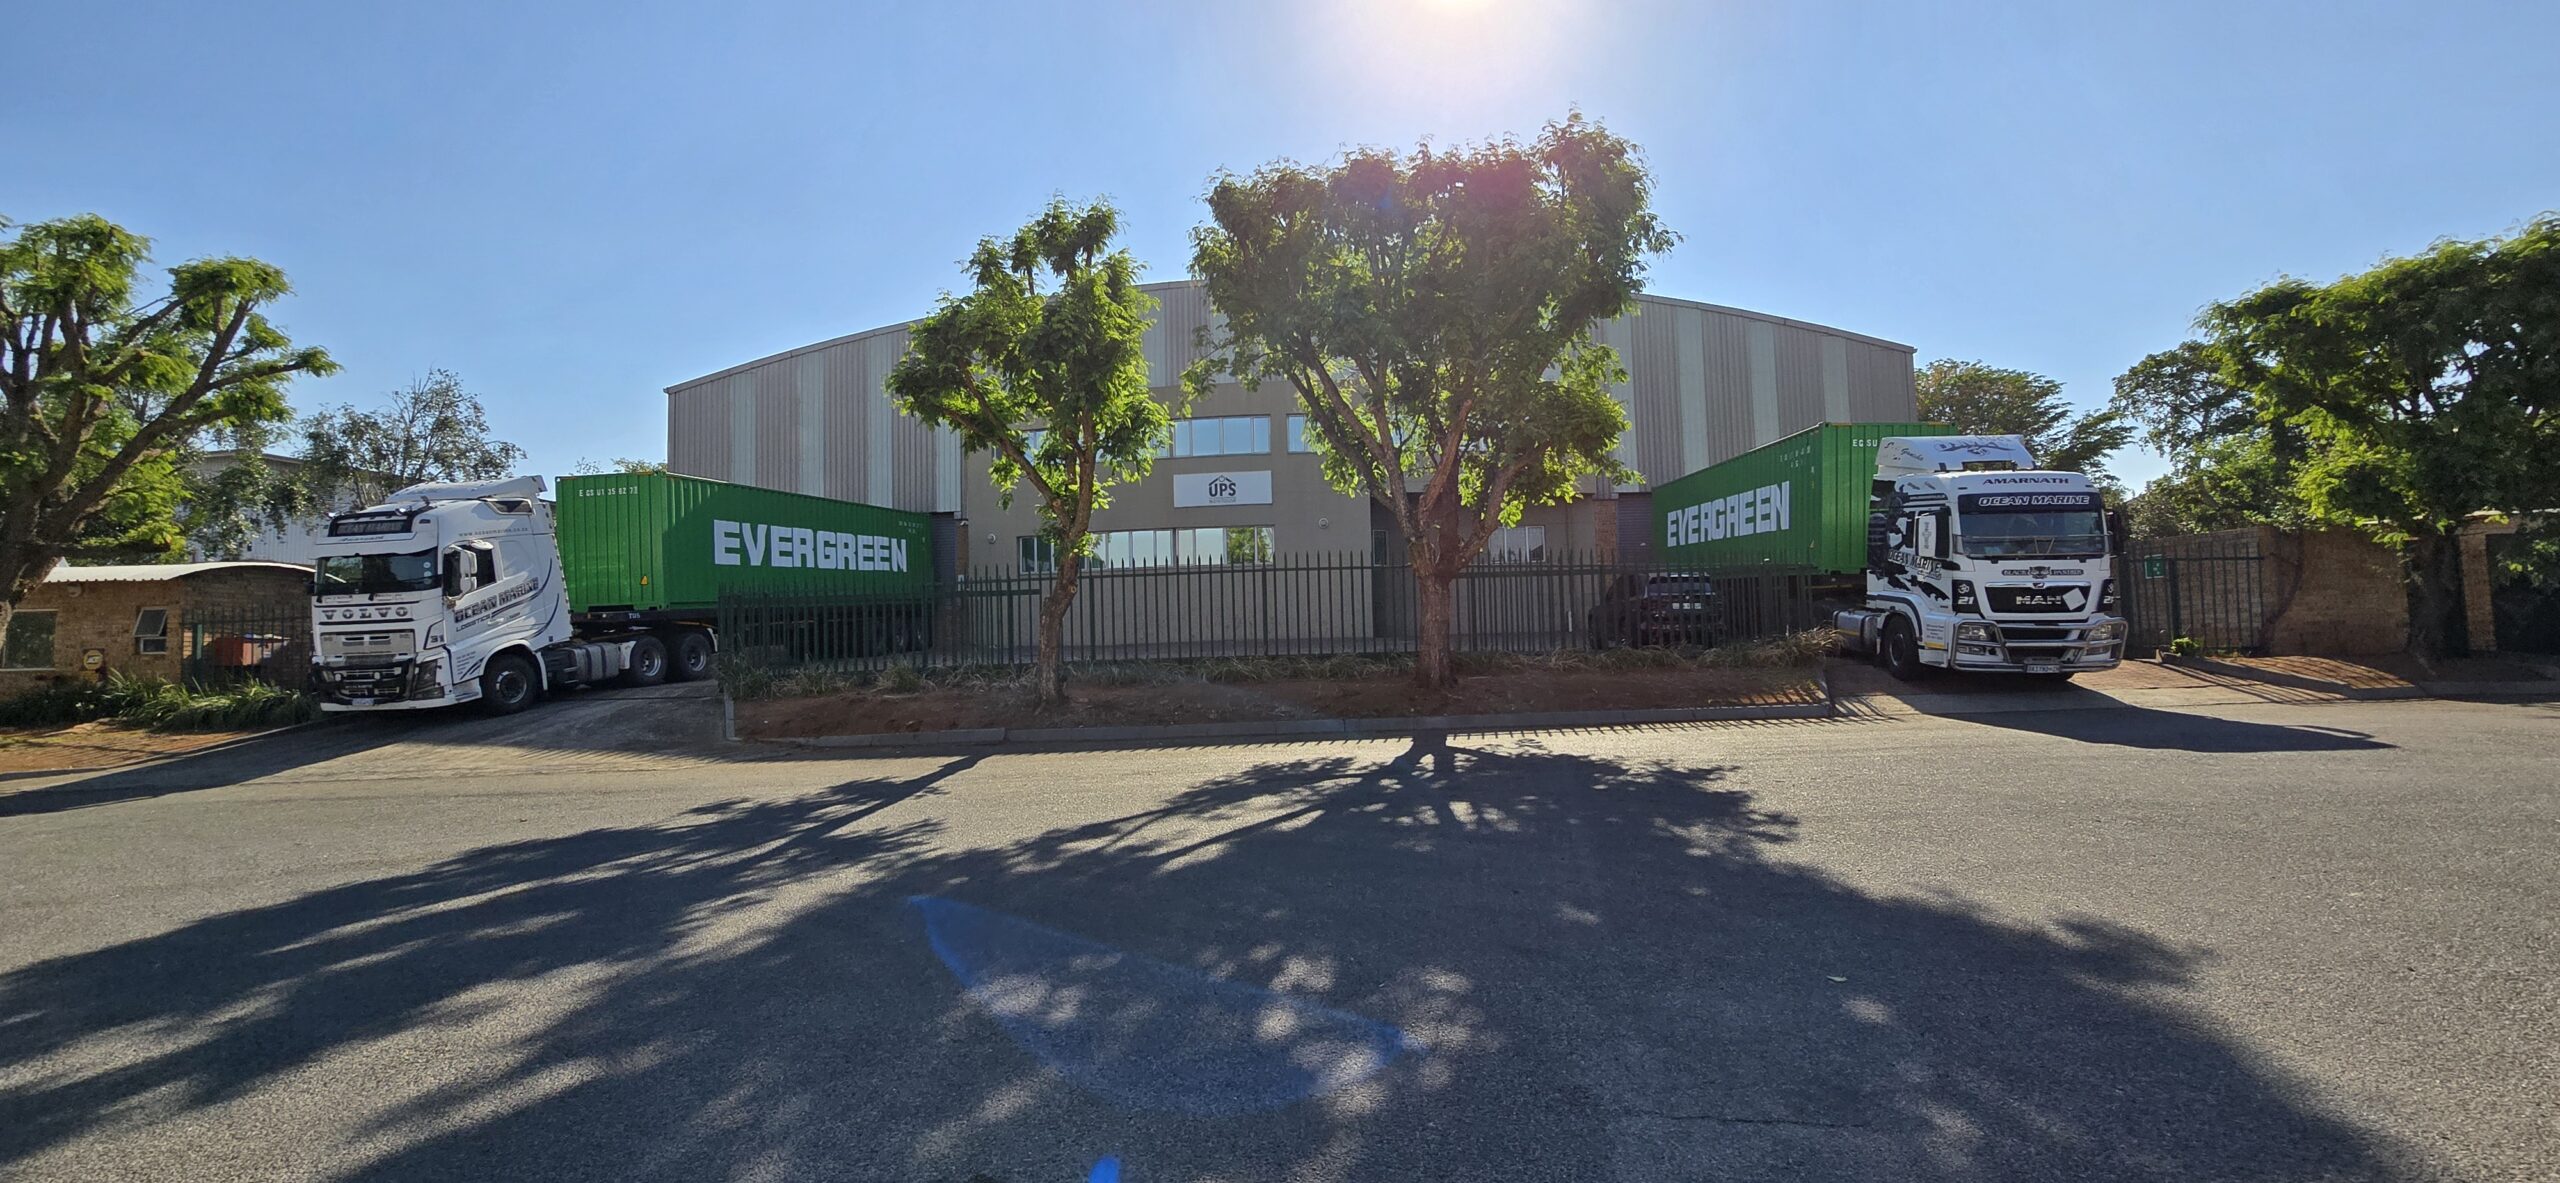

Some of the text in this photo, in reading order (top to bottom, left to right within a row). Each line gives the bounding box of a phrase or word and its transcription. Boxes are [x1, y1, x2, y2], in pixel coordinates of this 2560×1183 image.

[1983, 477, 2069, 485] AMARNATH
[1208, 482, 1236, 497] UPS
[1979, 495, 2090, 506] OCEAN MARINE
[1667, 480, 1790, 548] EVERGREEN
[713, 519, 908, 573] EVERGREEN
[453, 577, 539, 623] OCEAN MARINE
[1957, 596, 1973, 604] 21
[2016, 595, 2062, 605] MAN
[321, 606, 409, 620] VOLVO
